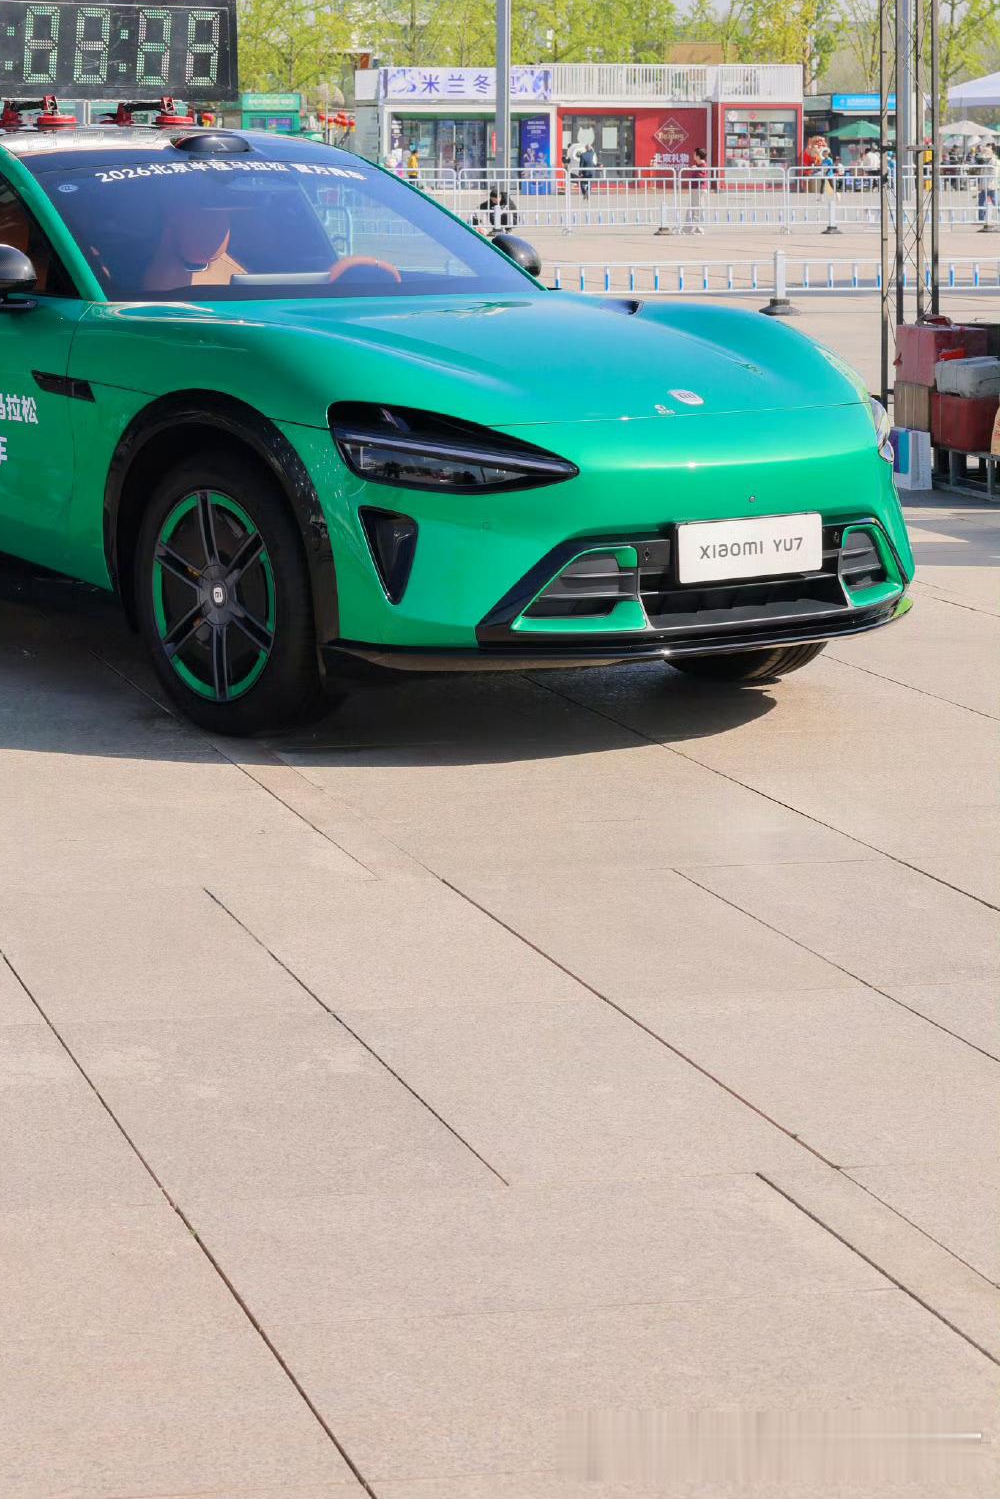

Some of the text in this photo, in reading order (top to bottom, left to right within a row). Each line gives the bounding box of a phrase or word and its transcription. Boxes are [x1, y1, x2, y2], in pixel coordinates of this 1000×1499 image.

[95, 161, 290, 182] 2026北京半程马拉松
[772, 537, 803, 553] YU7
